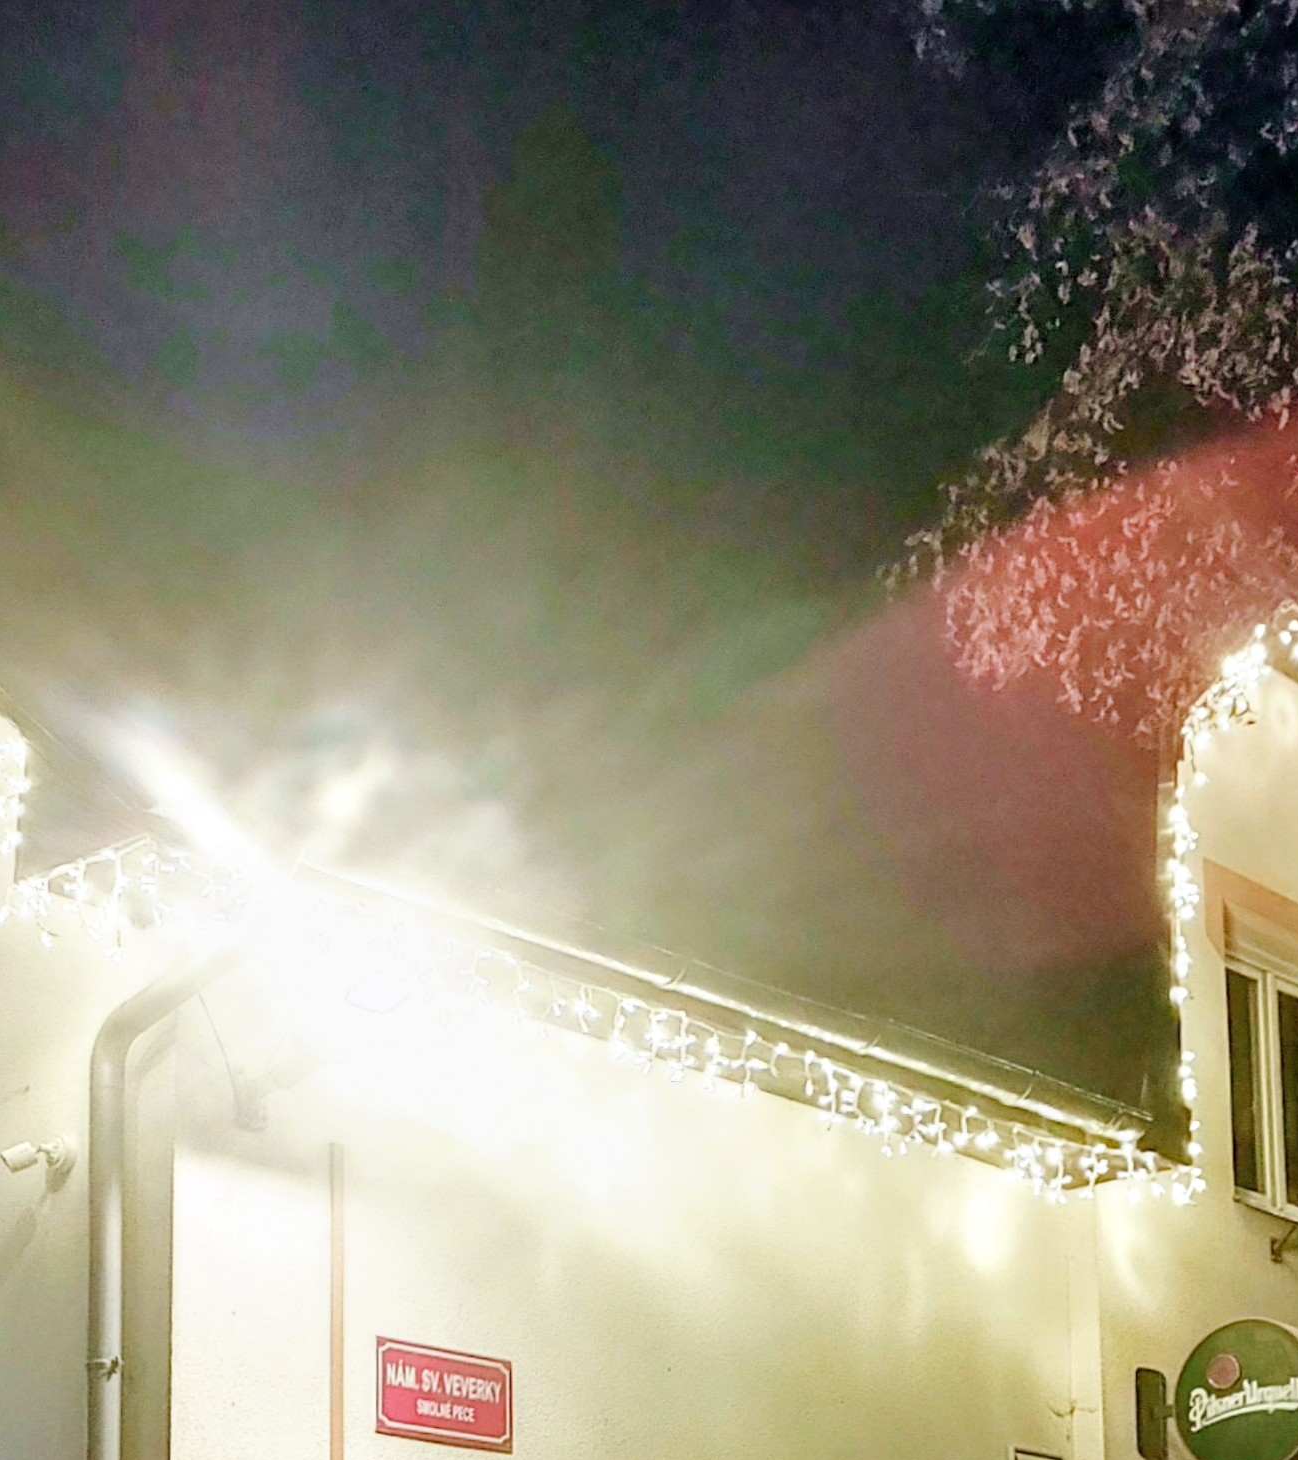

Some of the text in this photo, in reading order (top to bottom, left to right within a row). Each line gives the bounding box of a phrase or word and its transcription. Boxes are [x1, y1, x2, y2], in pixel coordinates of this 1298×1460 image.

[386, 1360, 502, 1403] NÁM. SV. VEVERKY
[453, 1404, 475, 1422] PECE
[1189, 1387, 1244, 1432] Pilsner
